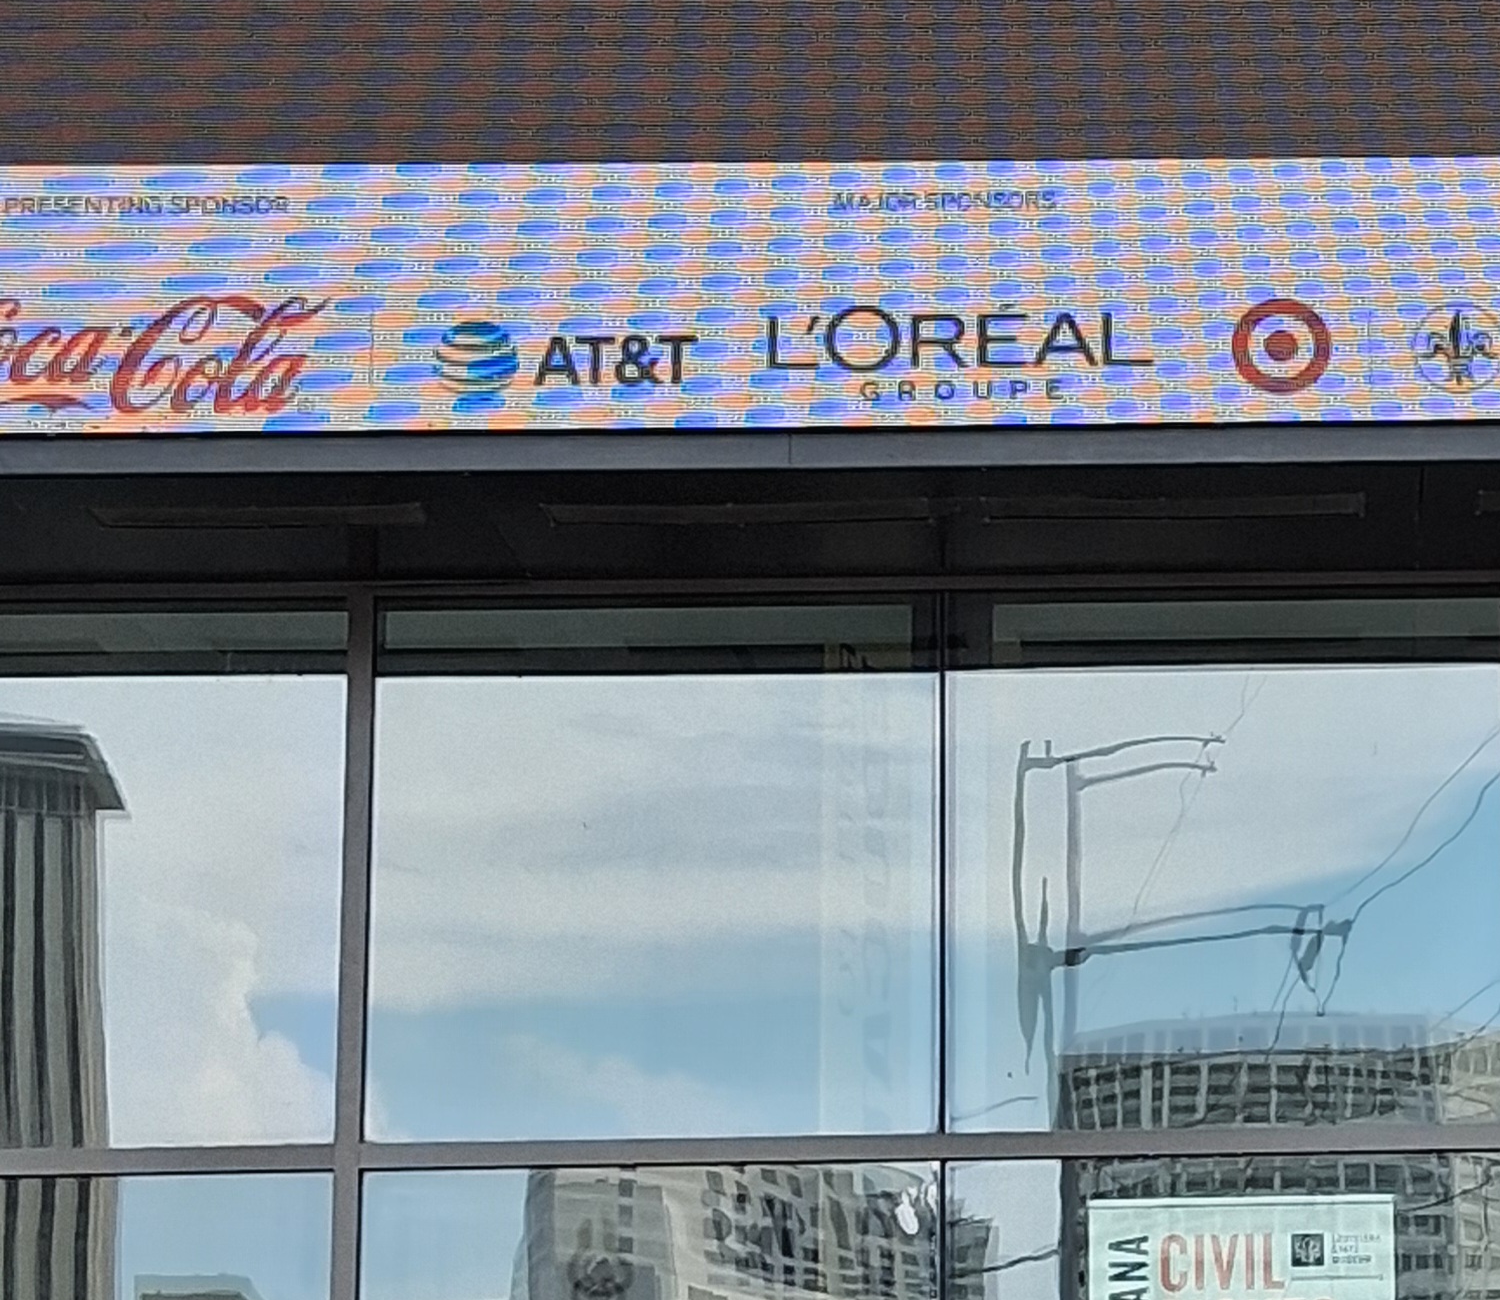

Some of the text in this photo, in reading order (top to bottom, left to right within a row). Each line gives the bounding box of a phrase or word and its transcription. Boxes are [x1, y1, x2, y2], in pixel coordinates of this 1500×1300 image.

[3, 195, 290, 217] PRESENTING SPONSOR
[831, 190, 1060, 213] MAJOR SPONSORS
[533, 334, 698, 385] AT&T
[860, 379, 1065, 401] GROUPE
[1159, 1231, 1286, 1293] CIVIL
